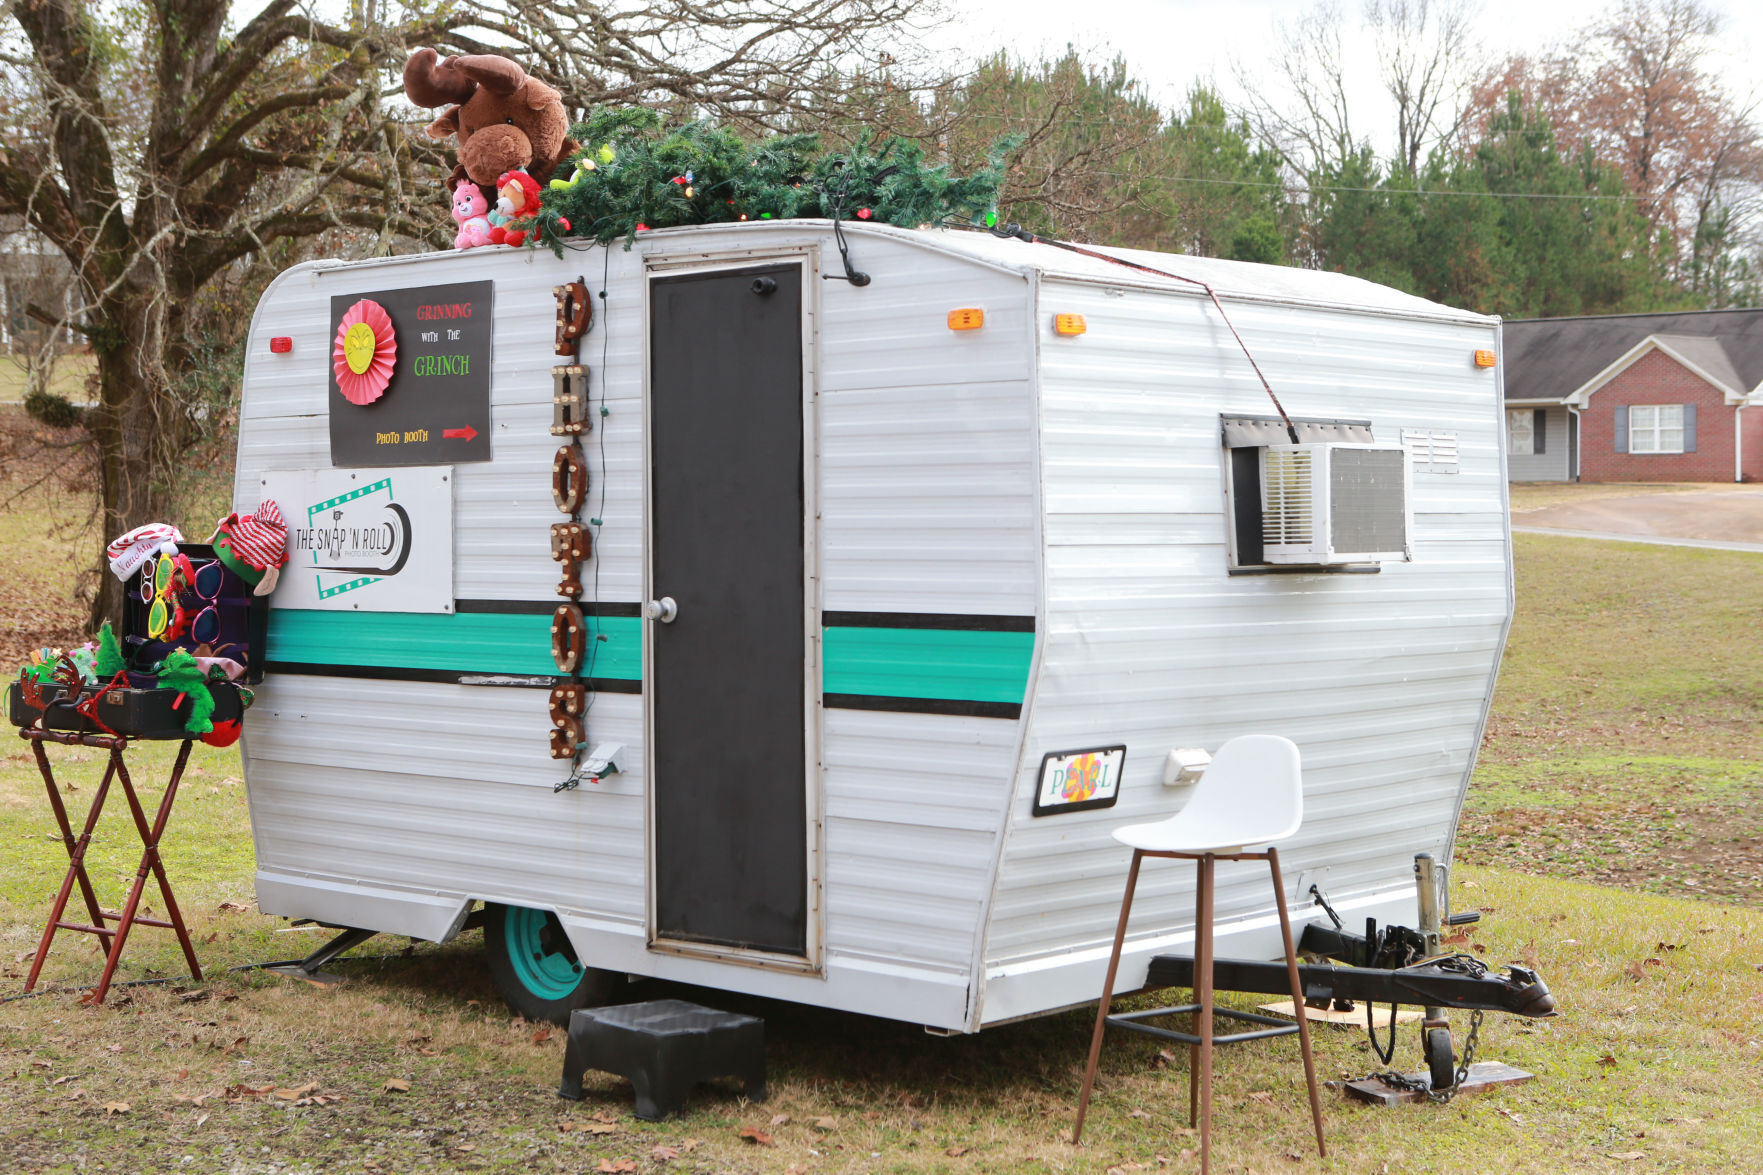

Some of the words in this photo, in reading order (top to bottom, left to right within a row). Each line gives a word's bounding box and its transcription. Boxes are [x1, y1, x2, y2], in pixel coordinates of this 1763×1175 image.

[416, 302, 472, 320] GRINNING
[421, 331, 439, 343] WITH
[447, 329, 461, 341] THE
[414, 355, 470, 377] GRINCH
[376, 431, 400, 444] PHOTO
[404, 429, 429, 443] BOOTH
[549, 281, 592, 760] PHOTOS
[296, 529, 314, 550] THE
[317, 528, 346, 556] SNAP
[363, 528, 387, 550] ROLL
[344, 550, 362, 558] PHOTO
[1050, 764, 1112, 795] PEARL
